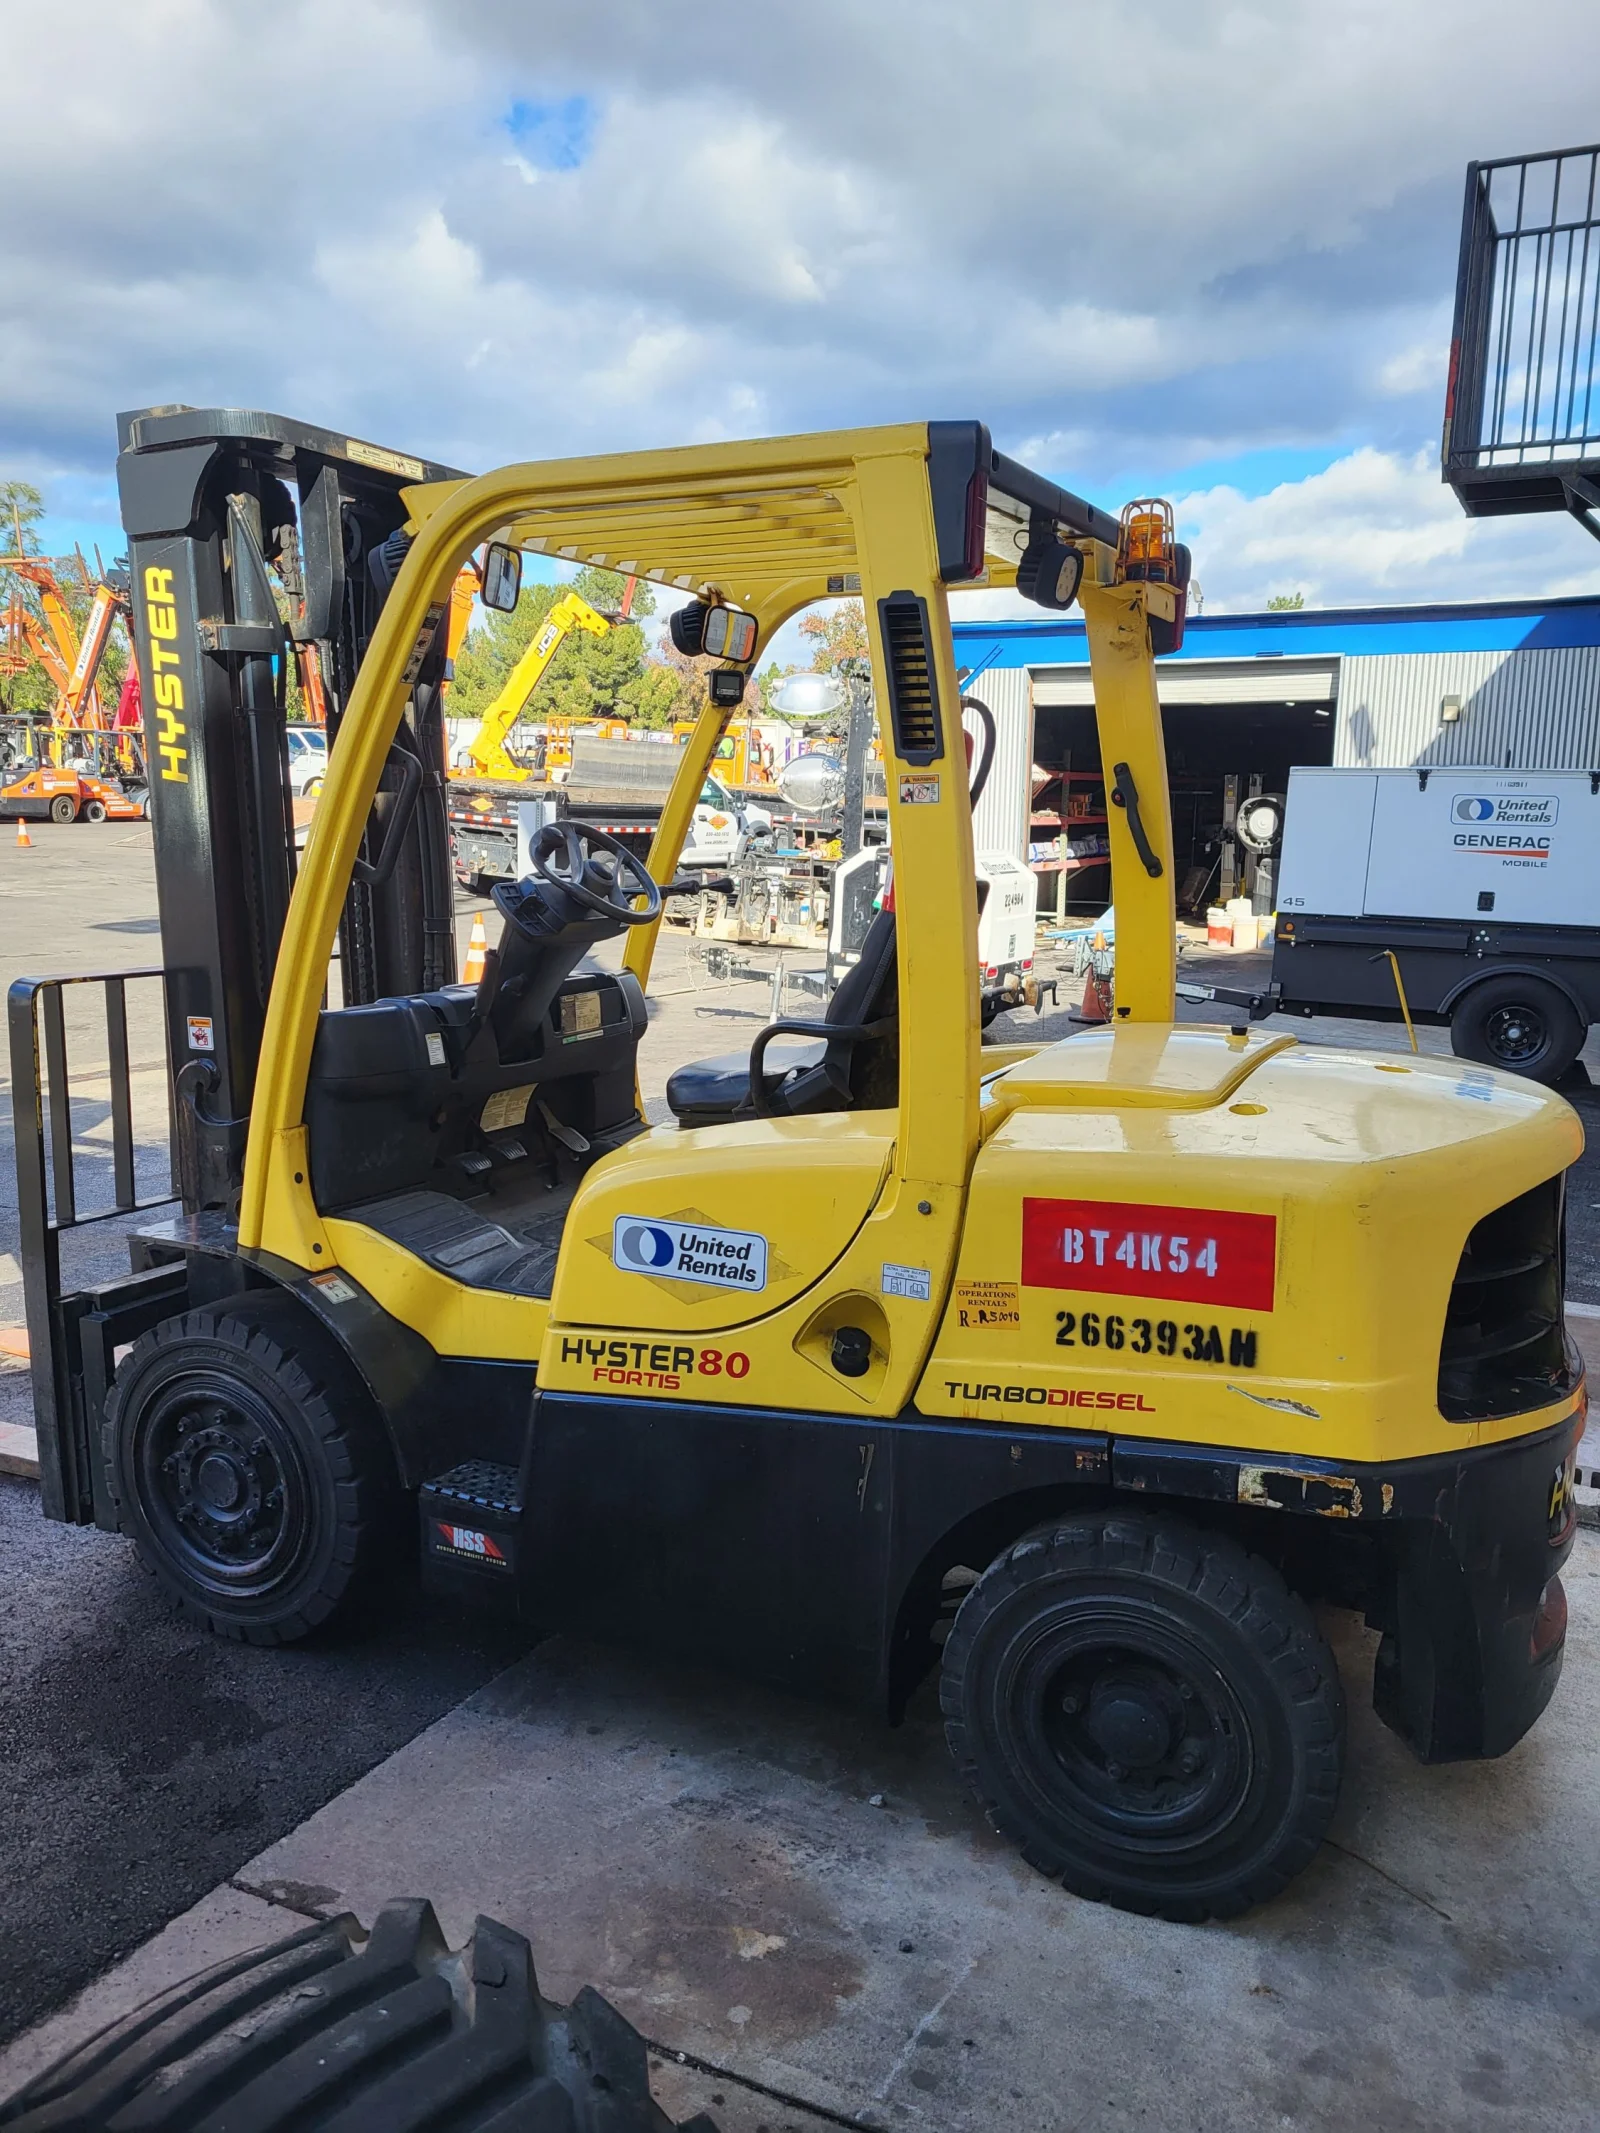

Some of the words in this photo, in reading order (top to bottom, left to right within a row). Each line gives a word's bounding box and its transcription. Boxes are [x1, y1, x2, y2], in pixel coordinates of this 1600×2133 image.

[535, 623, 559, 658] JCB
[145, 566, 189, 784] HYSTER
[1497, 799, 1549, 811] United
[1496, 811, 1552, 823] Rentals
[1453, 834, 1550, 849] GENERAC
[1502, 859, 1548, 868] MOBILE
[1283, 897, 1305, 906] 45
[679, 1233, 752, 1260] United
[1064, 1228, 1218, 1277] BT4K54
[677, 1254, 757, 1282] Rentals
[958, 1290, 1017, 1299] OPERATIONS
[973, 1281, 1000, 1289] FLEET
[968, 1299, 1008, 1307] RENTALS
[561, 1338, 694, 1373] HYSTER
[698, 1349, 750, 1378] 80
[593, 1367, 680, 1389] FORTIS
[945, 1381, 1156, 1412] TURBODIESEL
[453, 1527, 486, 1553] HSS
